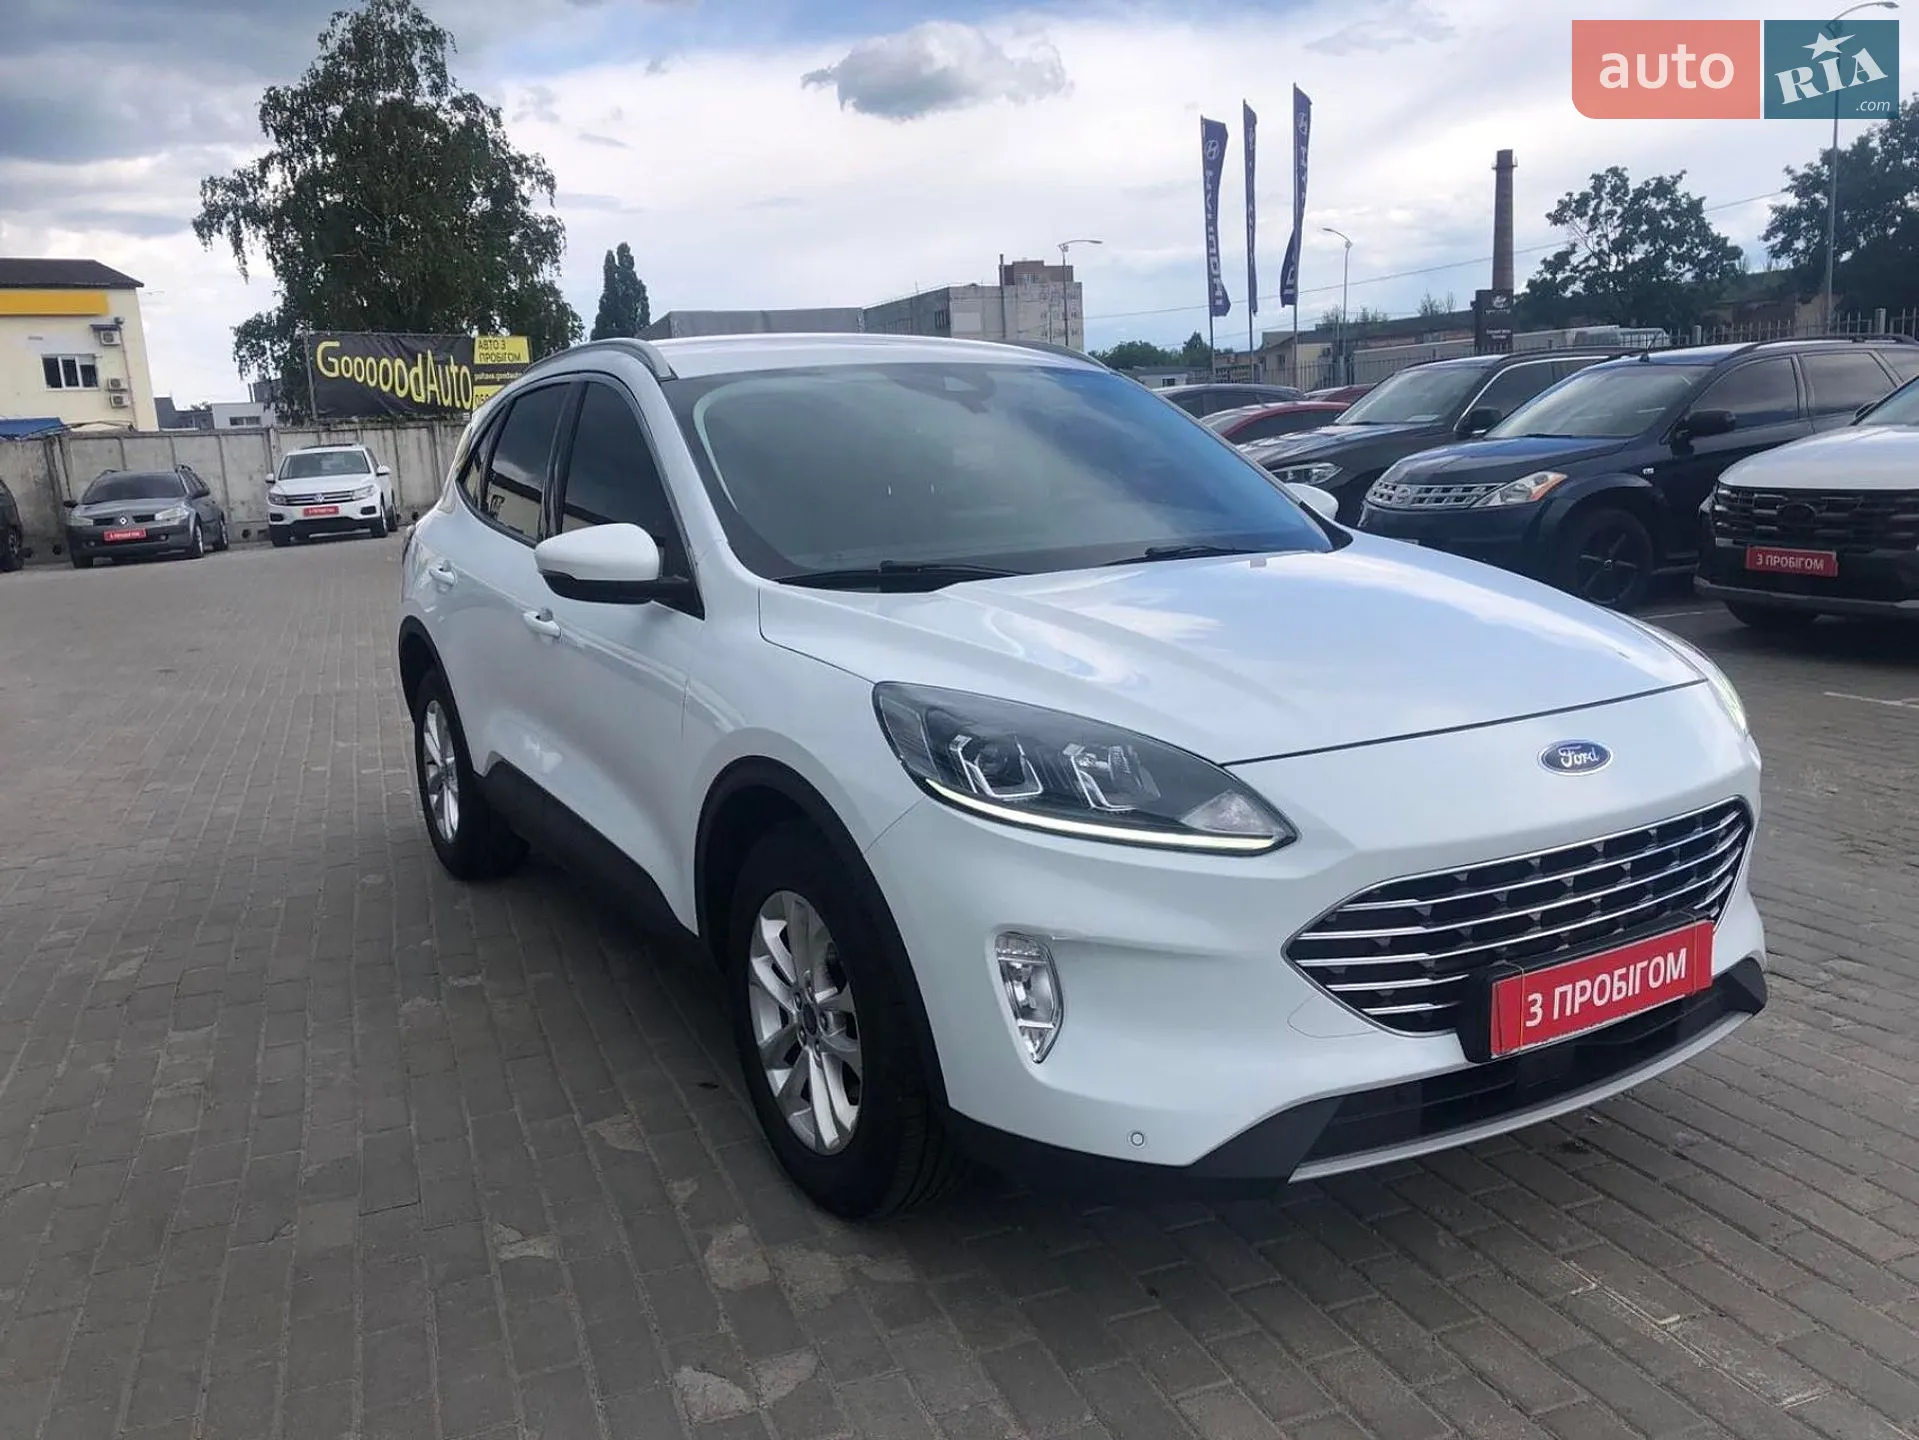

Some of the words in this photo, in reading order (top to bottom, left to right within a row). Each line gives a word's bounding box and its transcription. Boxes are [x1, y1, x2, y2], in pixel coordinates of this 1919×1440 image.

[1756, 554, 1764, 566] З
[1765, 555, 1825, 570] ПРОБІГОМ
[1558, 745, 1600, 768] Ford
[1525, 992, 1544, 1027] З
[1553, 948, 1688, 1020] ПРОБІГОМ
